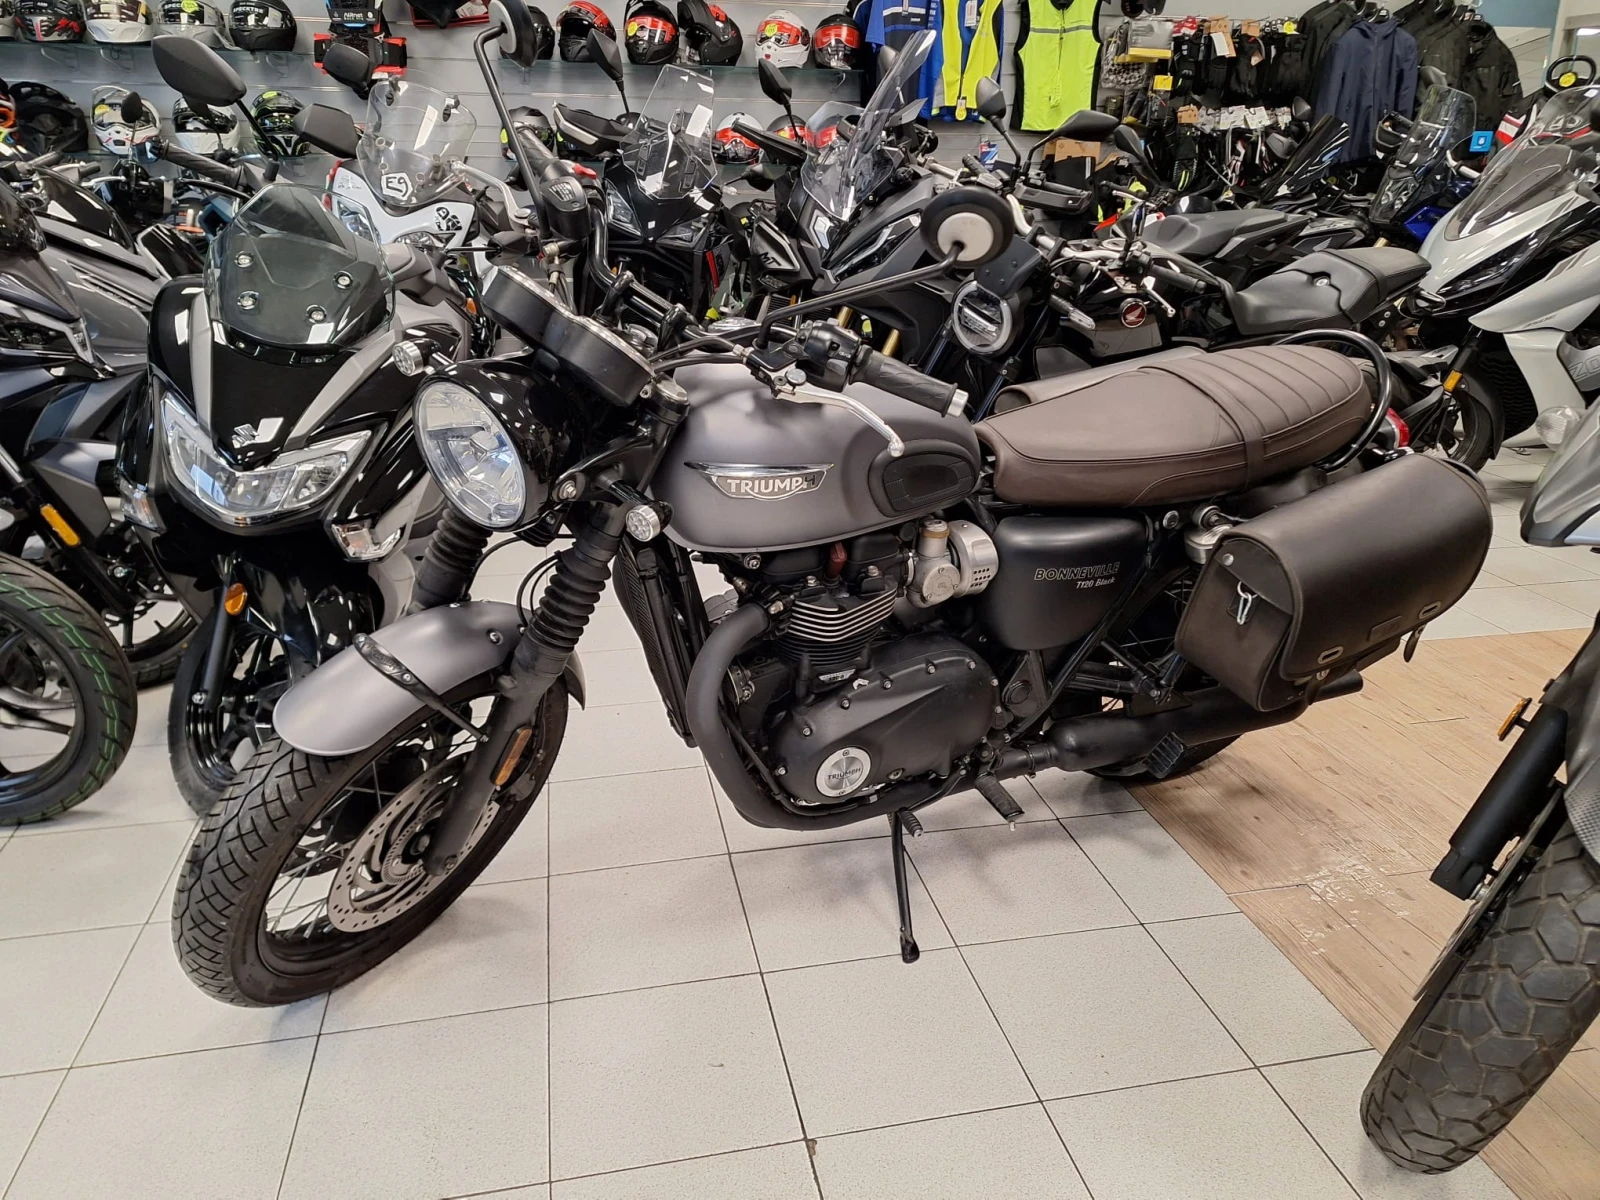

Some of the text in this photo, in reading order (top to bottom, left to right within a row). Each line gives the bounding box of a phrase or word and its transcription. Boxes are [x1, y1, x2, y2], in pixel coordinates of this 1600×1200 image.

[759, 251, 782, 267] MT
[727, 474, 816, 497] TRIUMPH
[1034, 562, 1120, 580] BONNEVILLE
[1076, 576, 1116, 589] T120 Black
[827, 767, 861, 780] TRIUMPH
